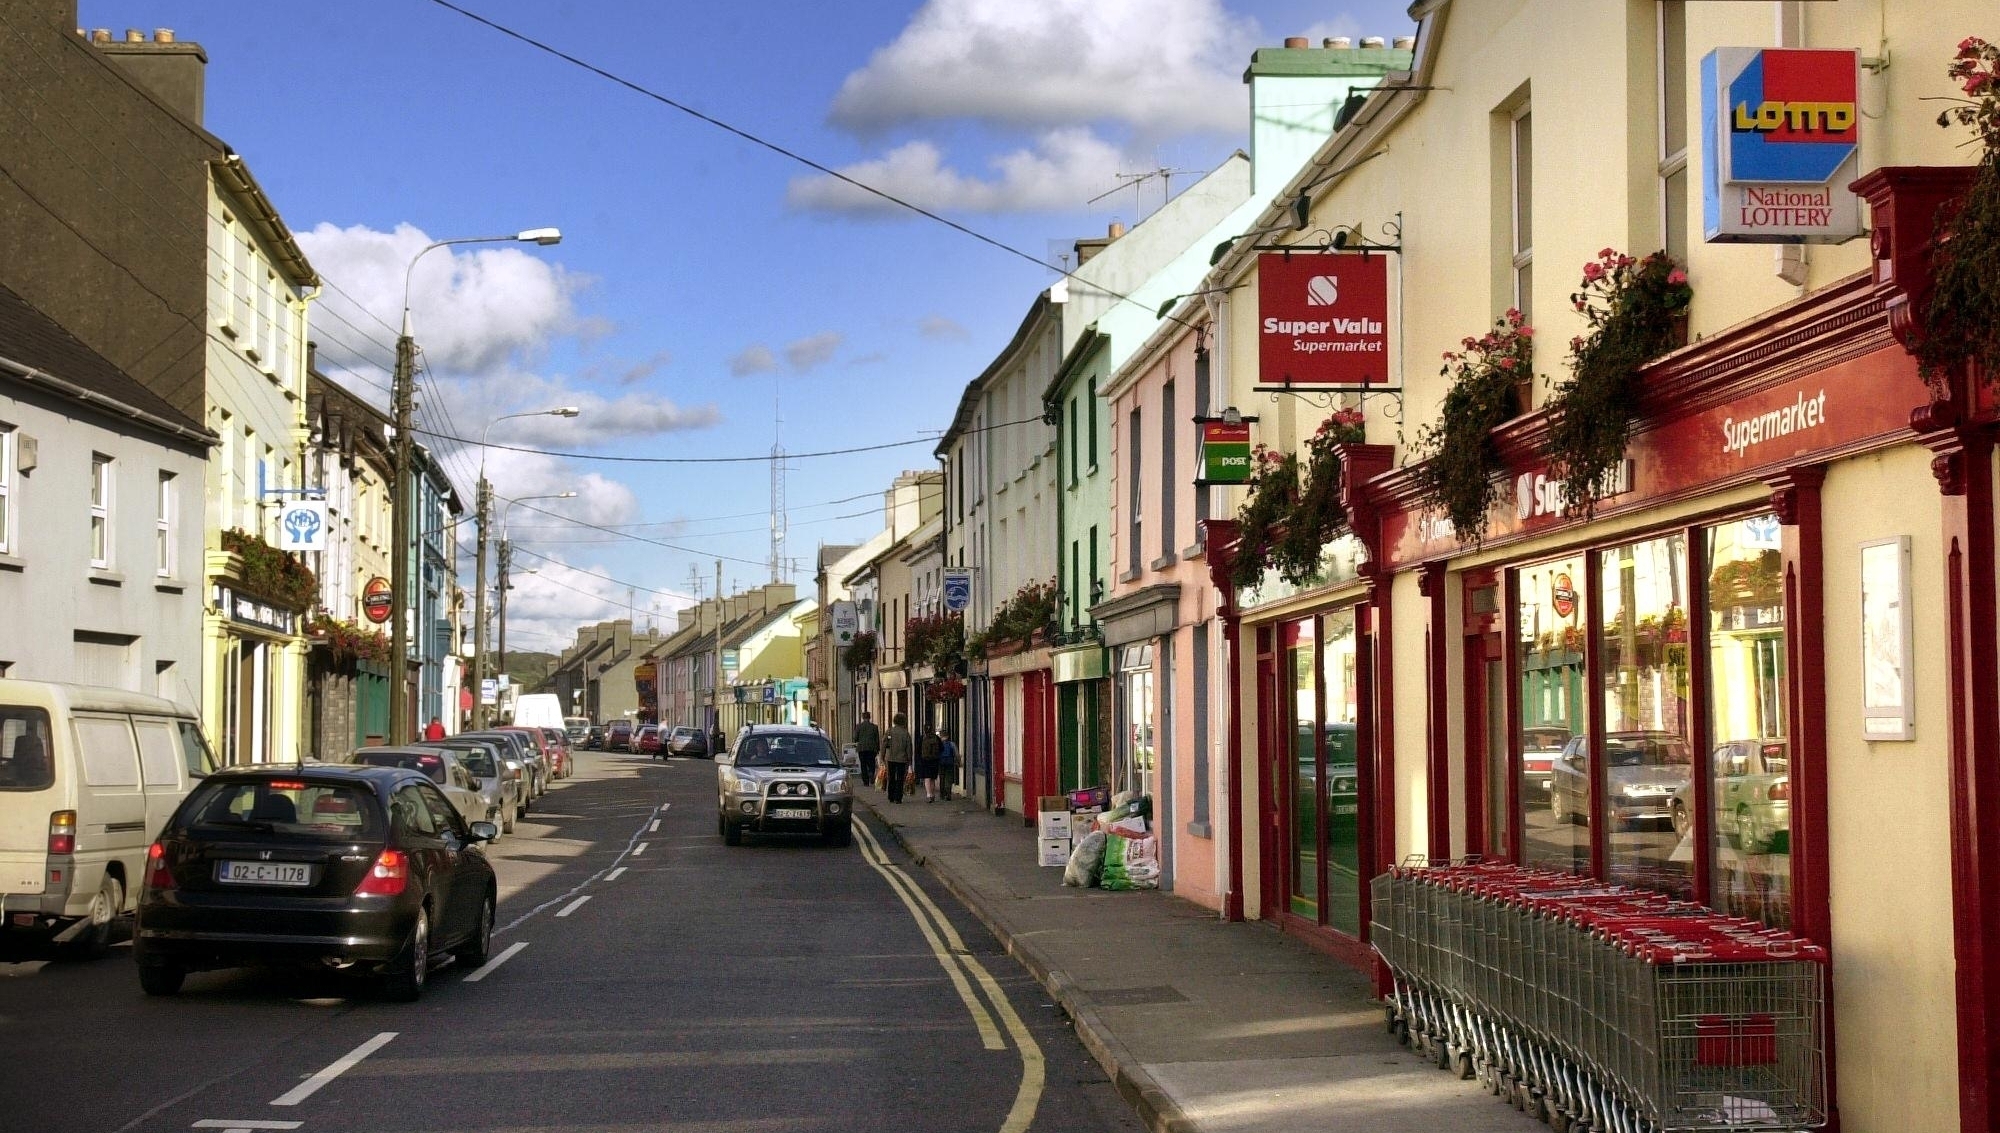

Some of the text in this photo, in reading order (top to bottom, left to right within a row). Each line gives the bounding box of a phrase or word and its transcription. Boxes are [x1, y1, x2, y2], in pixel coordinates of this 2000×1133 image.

[1734, 100, 1856, 132] LOTTO
[1747, 187, 1831, 206] National
[1741, 208, 1834, 228] LOTTERY
[1263, 317, 1382, 336] Super Valu
[1292, 338, 1382, 354] Supermarket
[1722, 388, 1827, 458] Supermarket
[233, 865, 304, 881] 02-C-1178
